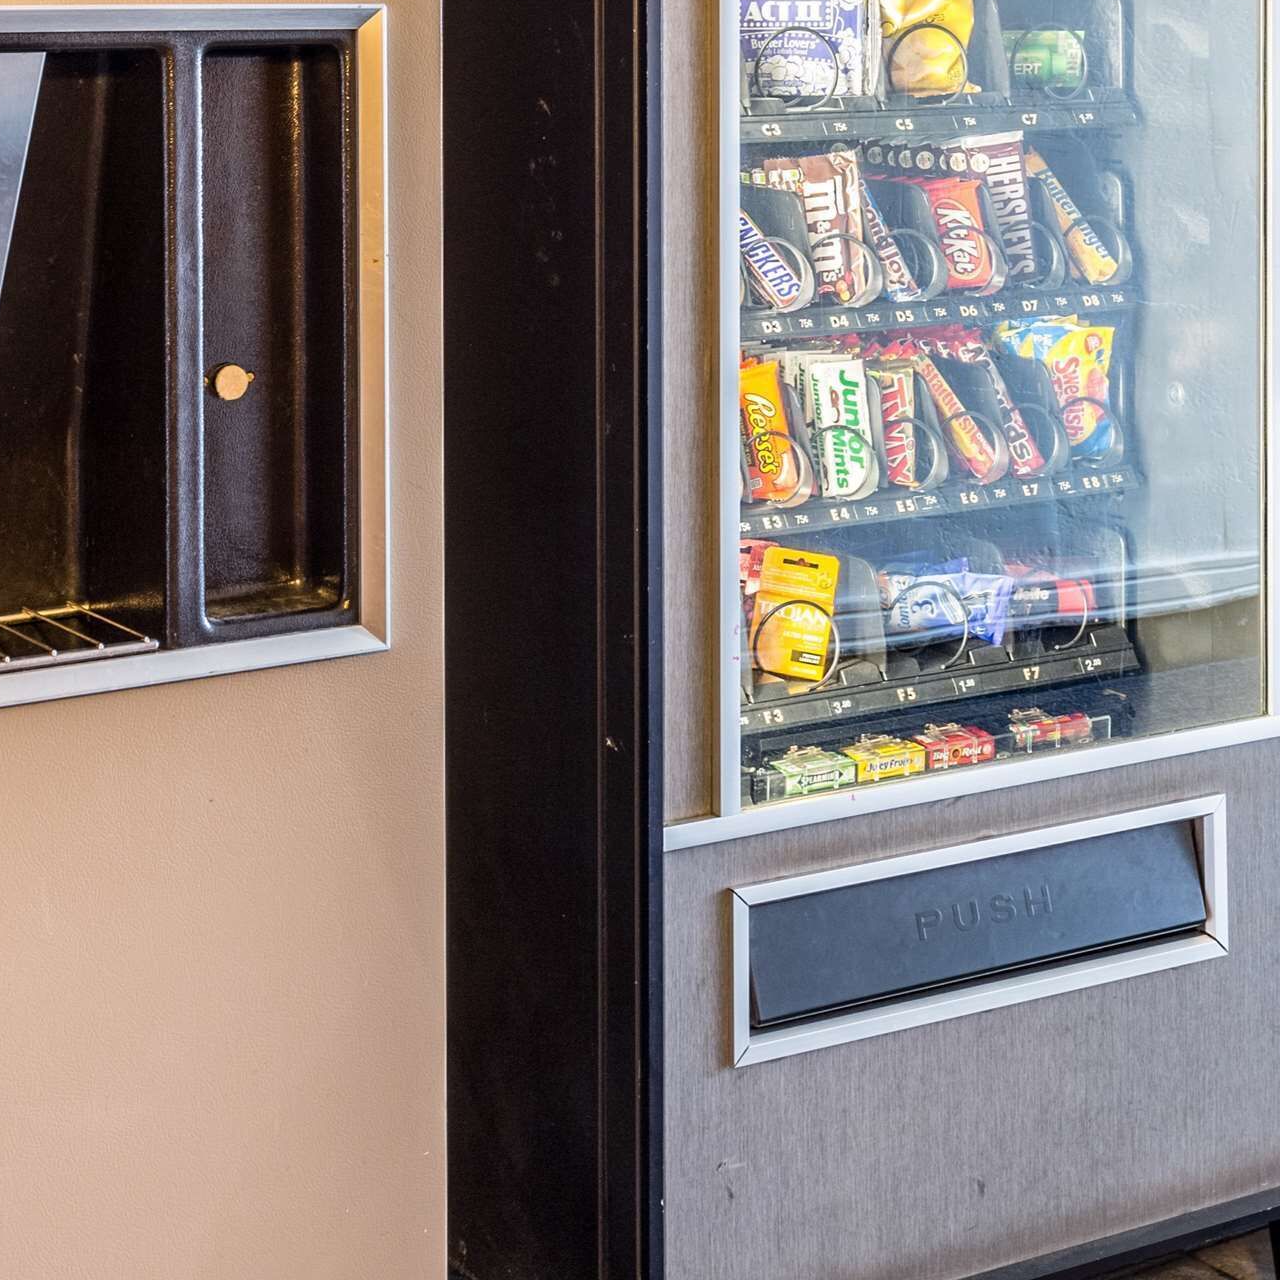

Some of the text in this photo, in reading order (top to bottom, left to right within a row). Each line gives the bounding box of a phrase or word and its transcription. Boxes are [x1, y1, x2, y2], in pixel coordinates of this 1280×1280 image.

[744, 1, 823, 21] ACT II
[783, 38, 816, 49] Lovers
[1014, 63, 1042, 75] ERT
[762, 124, 782, 136] C3
[896, 119, 914, 130] C5
[1022, 114, 1038, 125] C7
[986, 154, 1036, 278] HERSHEY'S
[740, 217, 800, 298] SNICKERS
[762, 322, 782, 333] D3
[830, 316, 850, 328] D4
[896, 310, 914, 322] D5
[960, 306, 978, 317] D6
[1022, 300, 1038, 312] D7
[1082, 295, 1100, 306] D8
[744, 393, 779, 474] Reese's
[831, 428, 850, 489] Mints
[760, 600, 829, 625] TROJAN
[915, 883, 1053, 941] PUSH
